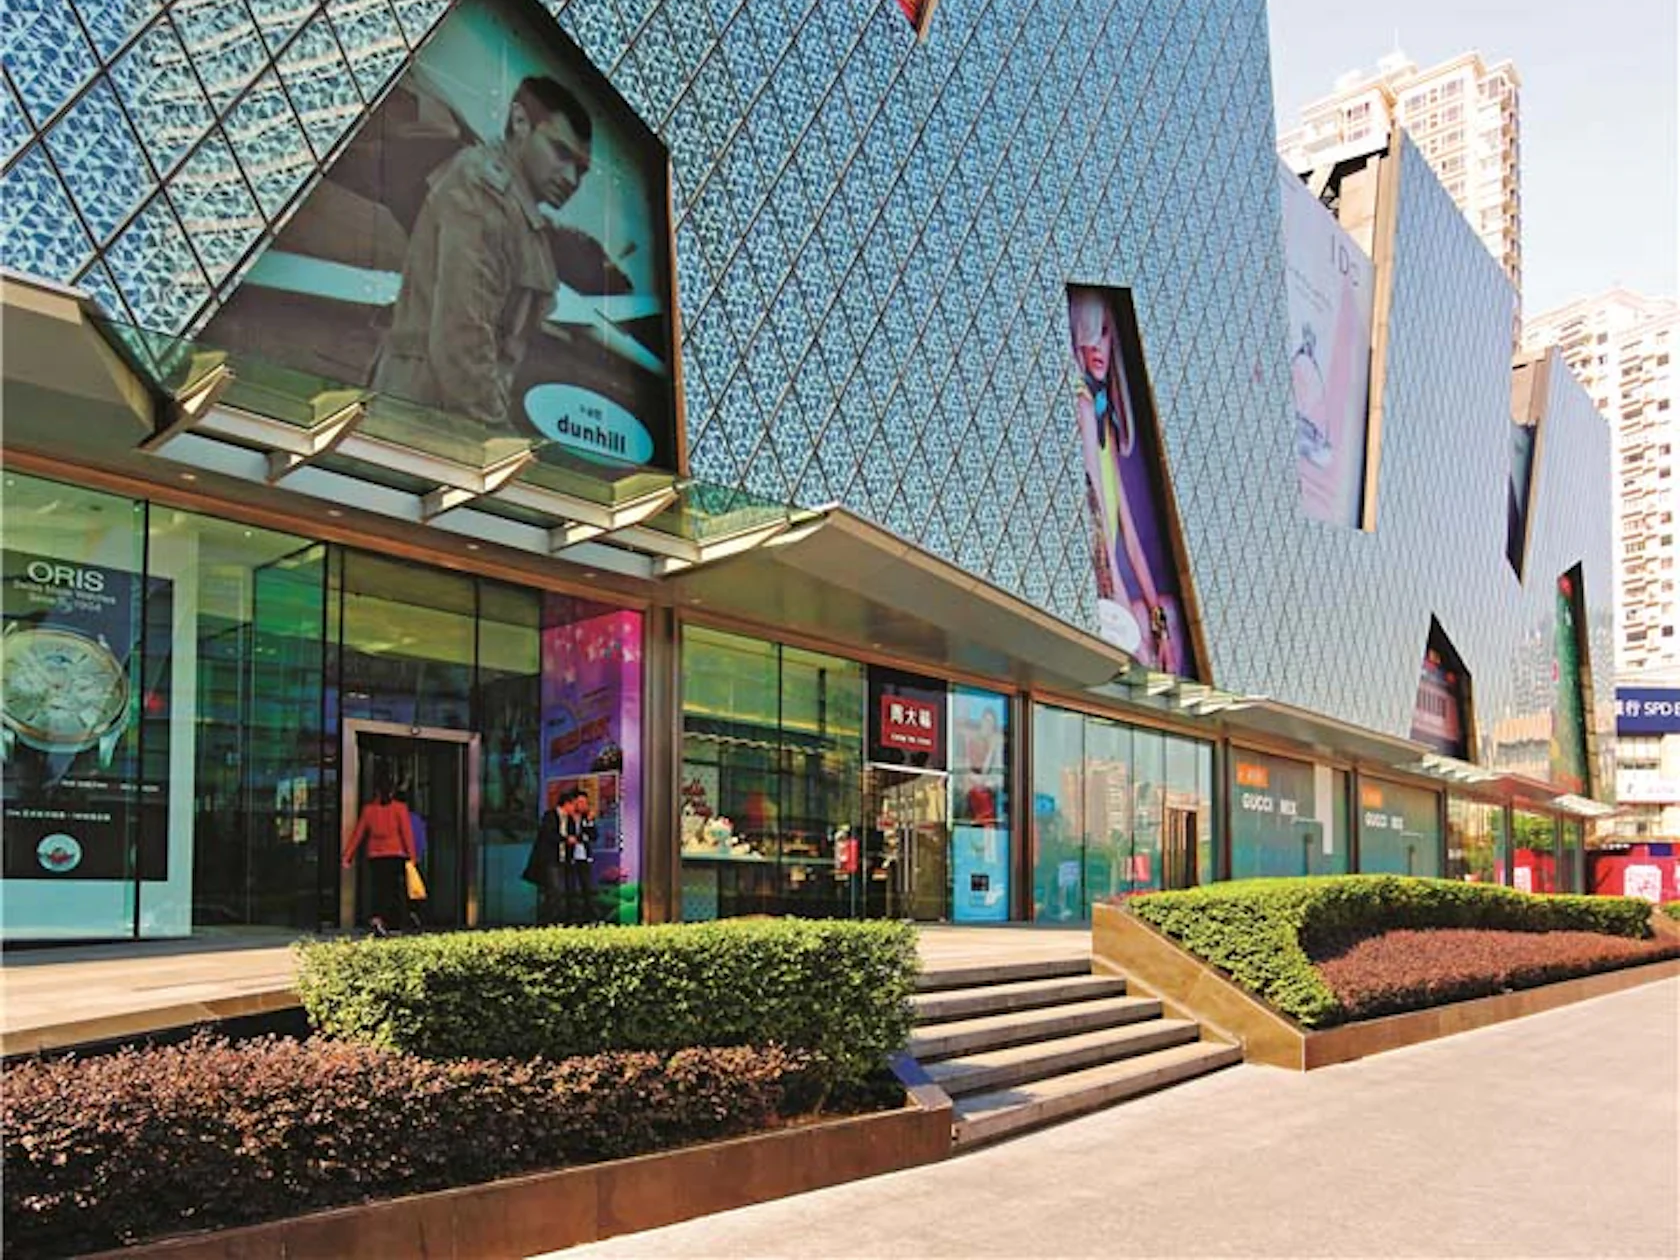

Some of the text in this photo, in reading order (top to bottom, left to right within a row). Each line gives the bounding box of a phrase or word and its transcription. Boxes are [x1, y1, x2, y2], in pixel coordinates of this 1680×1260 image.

[557, 414, 626, 454] dunhill
[27, 561, 104, 592] ORIS
[1643, 701, 1673, 717] SPD
